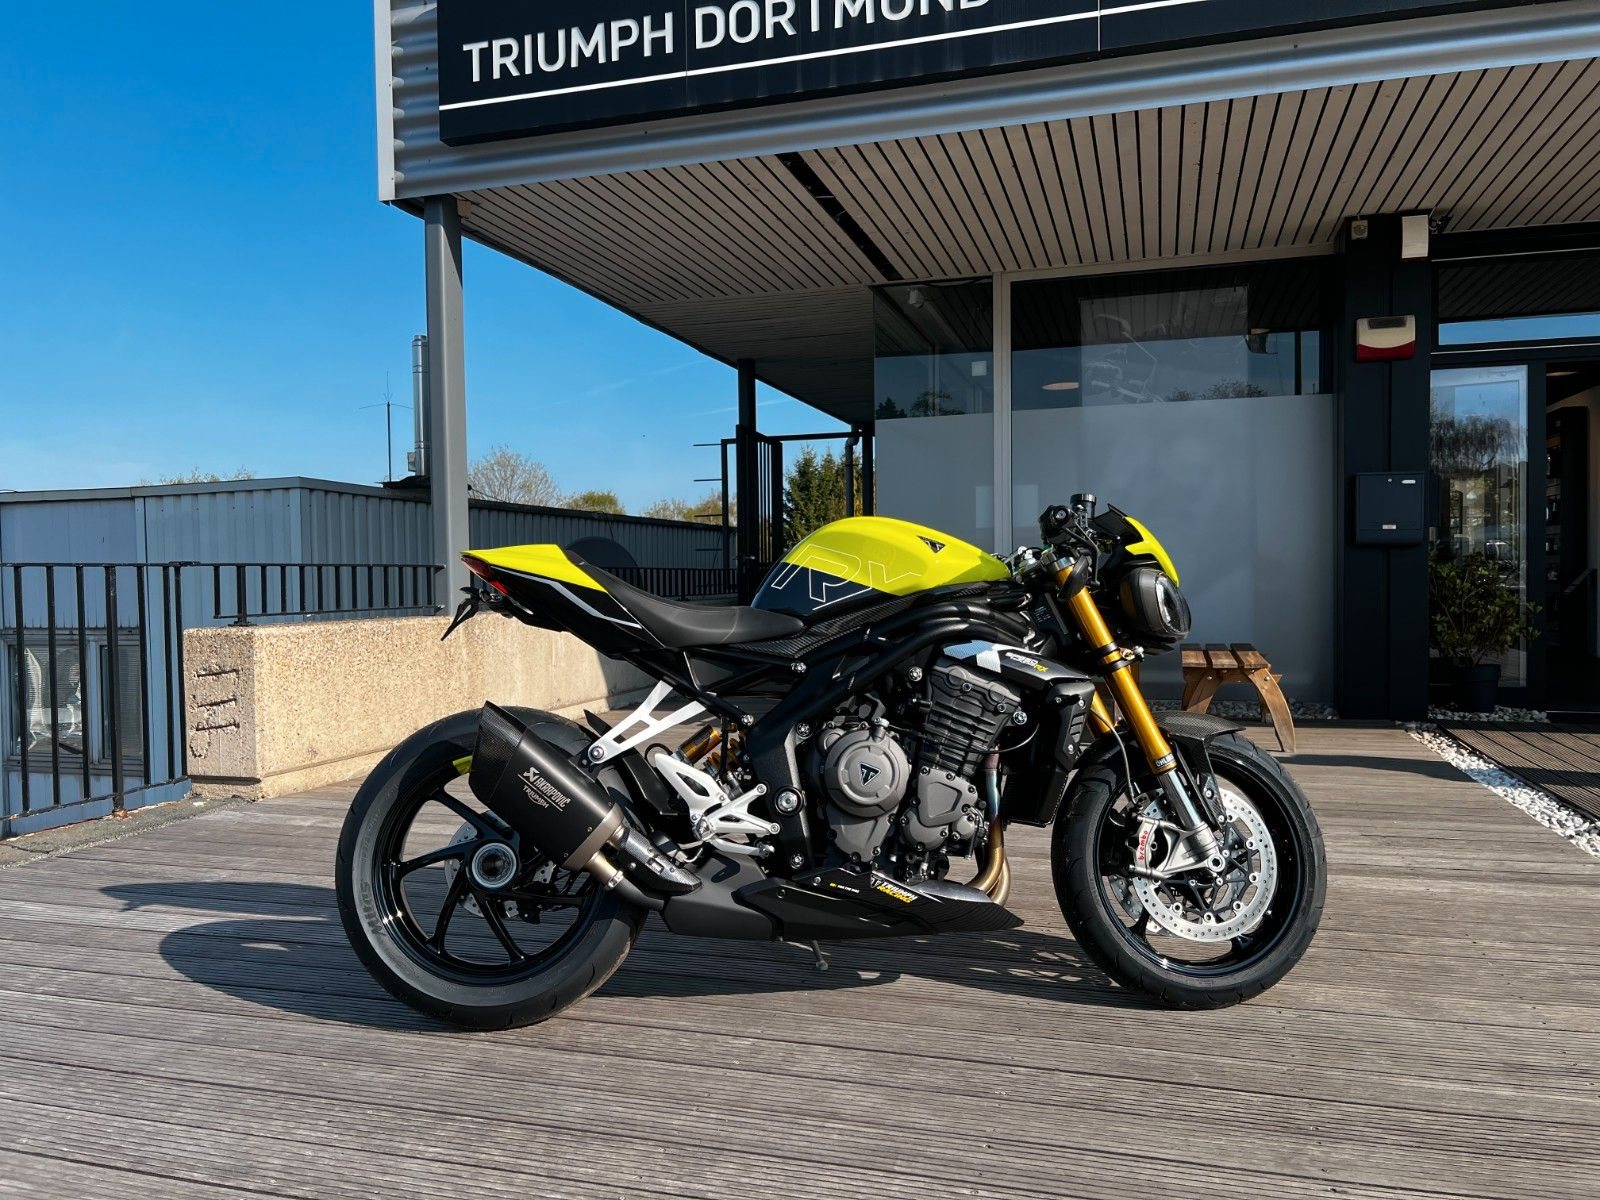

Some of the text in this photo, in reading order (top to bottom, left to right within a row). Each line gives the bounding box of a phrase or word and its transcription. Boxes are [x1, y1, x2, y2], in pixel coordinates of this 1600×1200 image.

[462, 0, 990, 83] TRIUMPH DORTM
[522, 784, 550, 809] TRIUMPH
[1137, 830, 1149, 862] brembo
[876, 885, 913, 903] RACING
[882, 881, 918, 900] TRIUMPH
